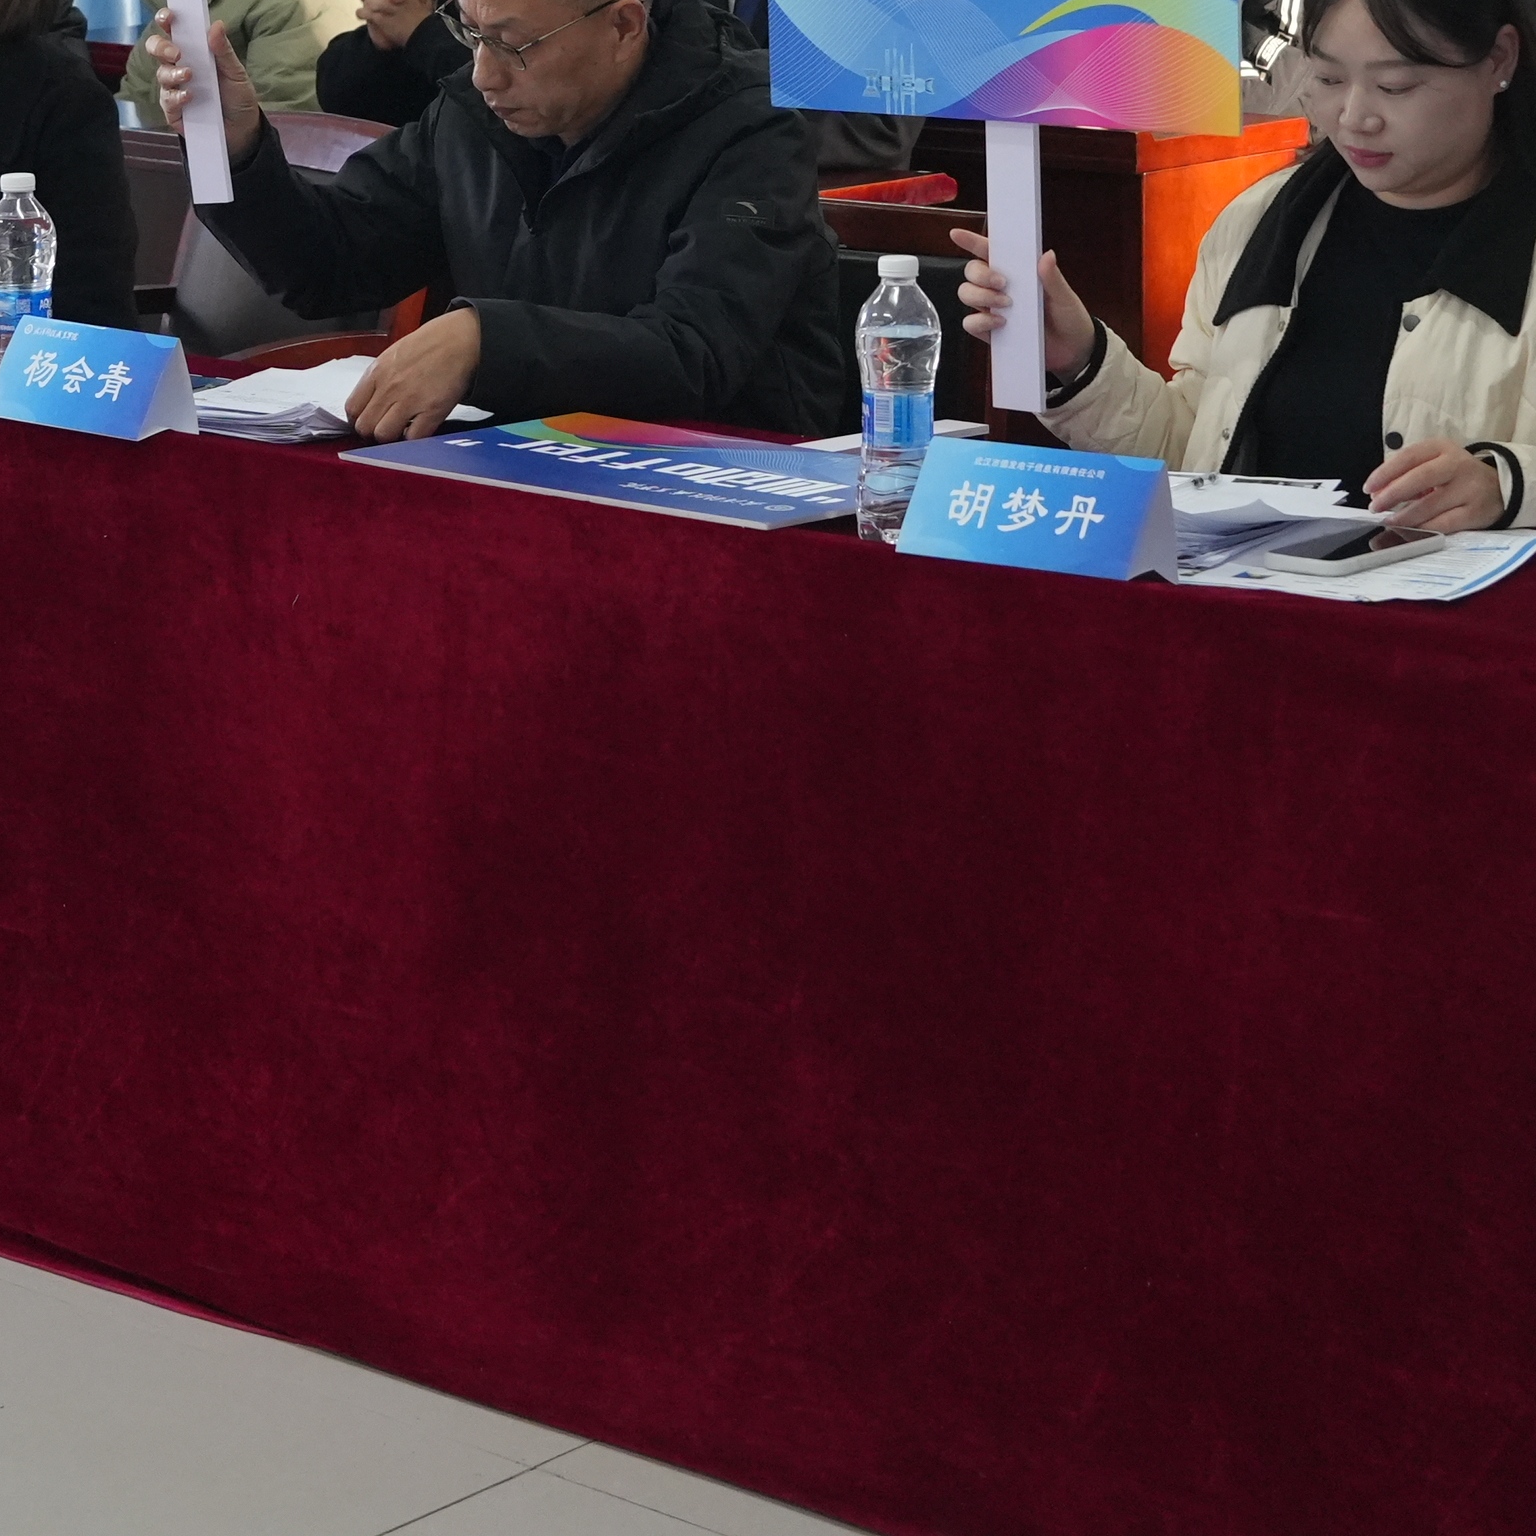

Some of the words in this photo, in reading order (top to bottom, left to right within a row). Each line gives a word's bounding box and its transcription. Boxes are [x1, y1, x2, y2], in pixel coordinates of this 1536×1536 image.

[23, 350, 132, 401] 杨会青
[948, 480, 1104, 539] 胡梦丹
